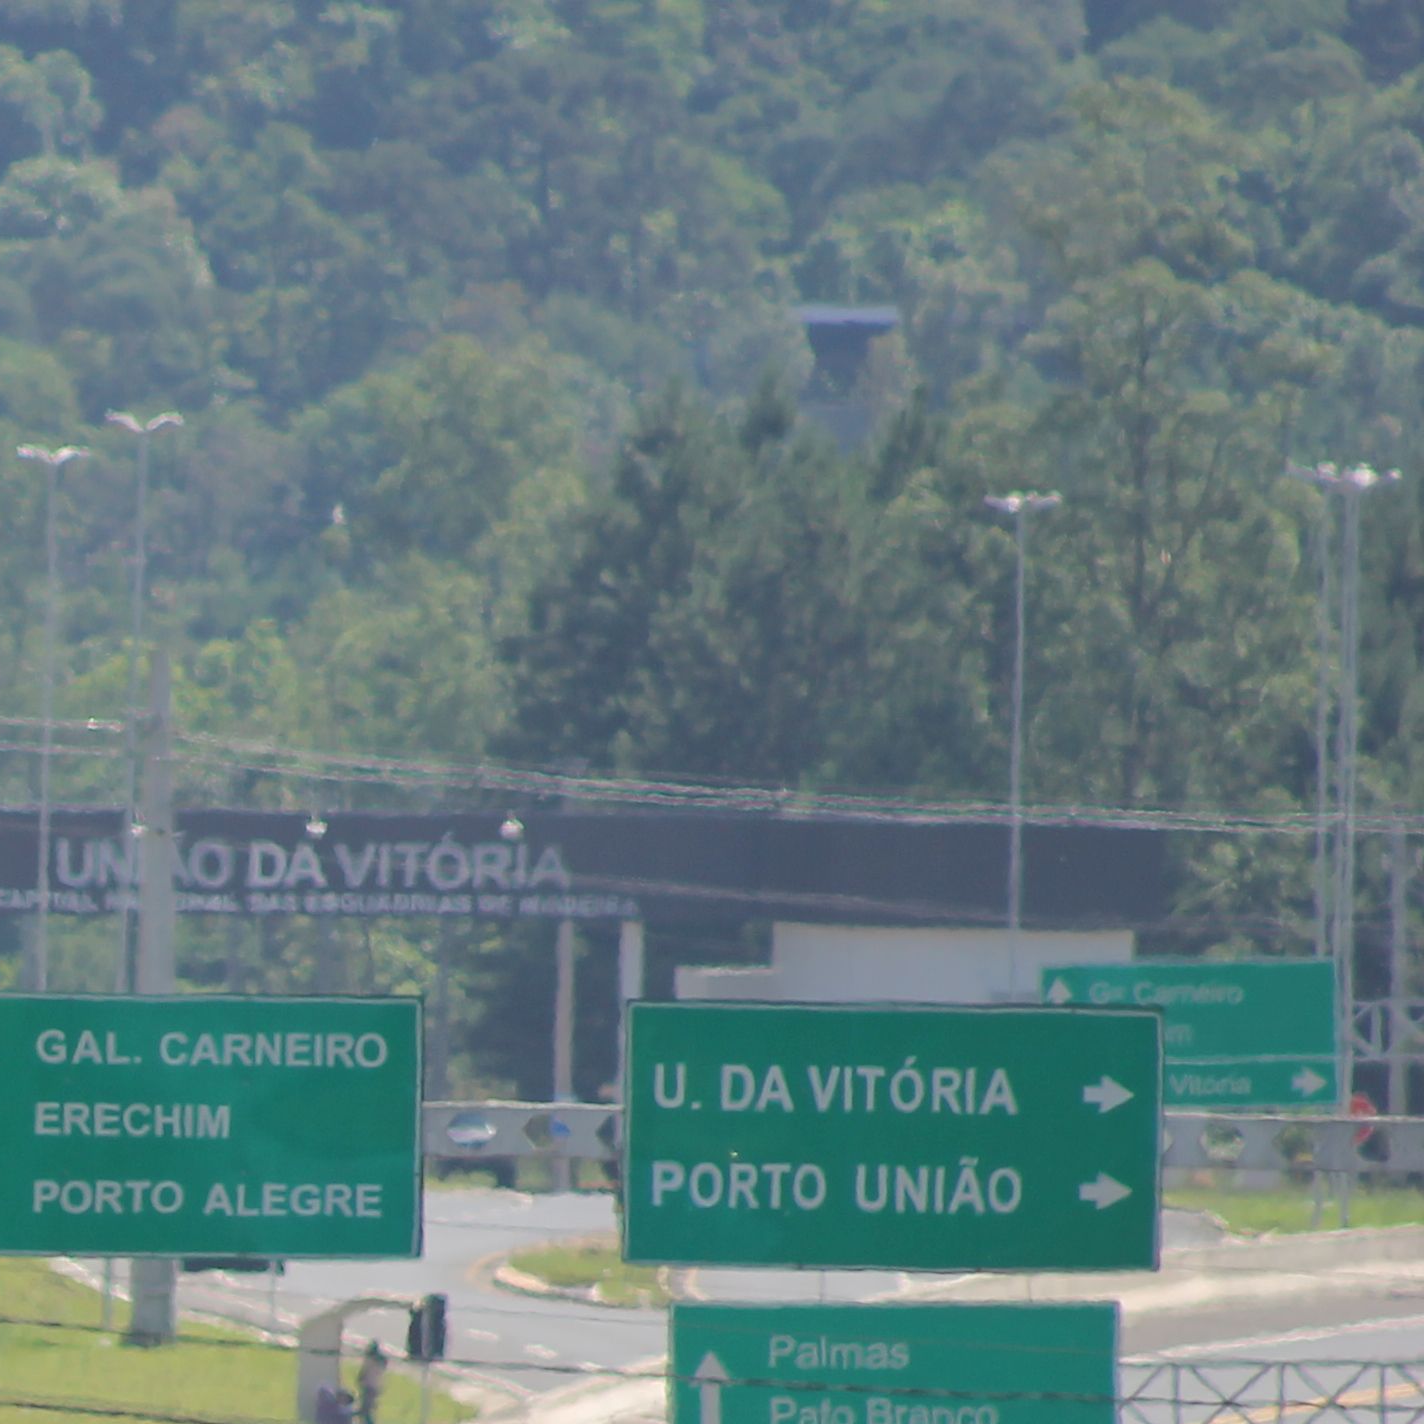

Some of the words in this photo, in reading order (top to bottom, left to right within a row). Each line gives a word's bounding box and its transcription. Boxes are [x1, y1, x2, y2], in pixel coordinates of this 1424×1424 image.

[56, 837, 233, 888] UNO
[246, 841, 326, 888] DA
[334, 832, 571, 890] VITÓRIA
[36, 1029, 142, 1066] GAL.
[158, 1032, 388, 1068] CARNEIRO
[653, 1061, 703, 1110] U.
[719, 1063, 795, 1112] DA
[807, 1056, 1019, 1115] VITÓRIA
[34, 1101, 231, 1139] ERECHIM
[32, 1179, 185, 1215] PORTO
[203, 1183, 384, 1218] ALEGRE
[651, 1159, 827, 1211] PORTO
[855, 1156, 1023, 1215] UNIÃO
[768, 1334, 911, 1370] Palmas
